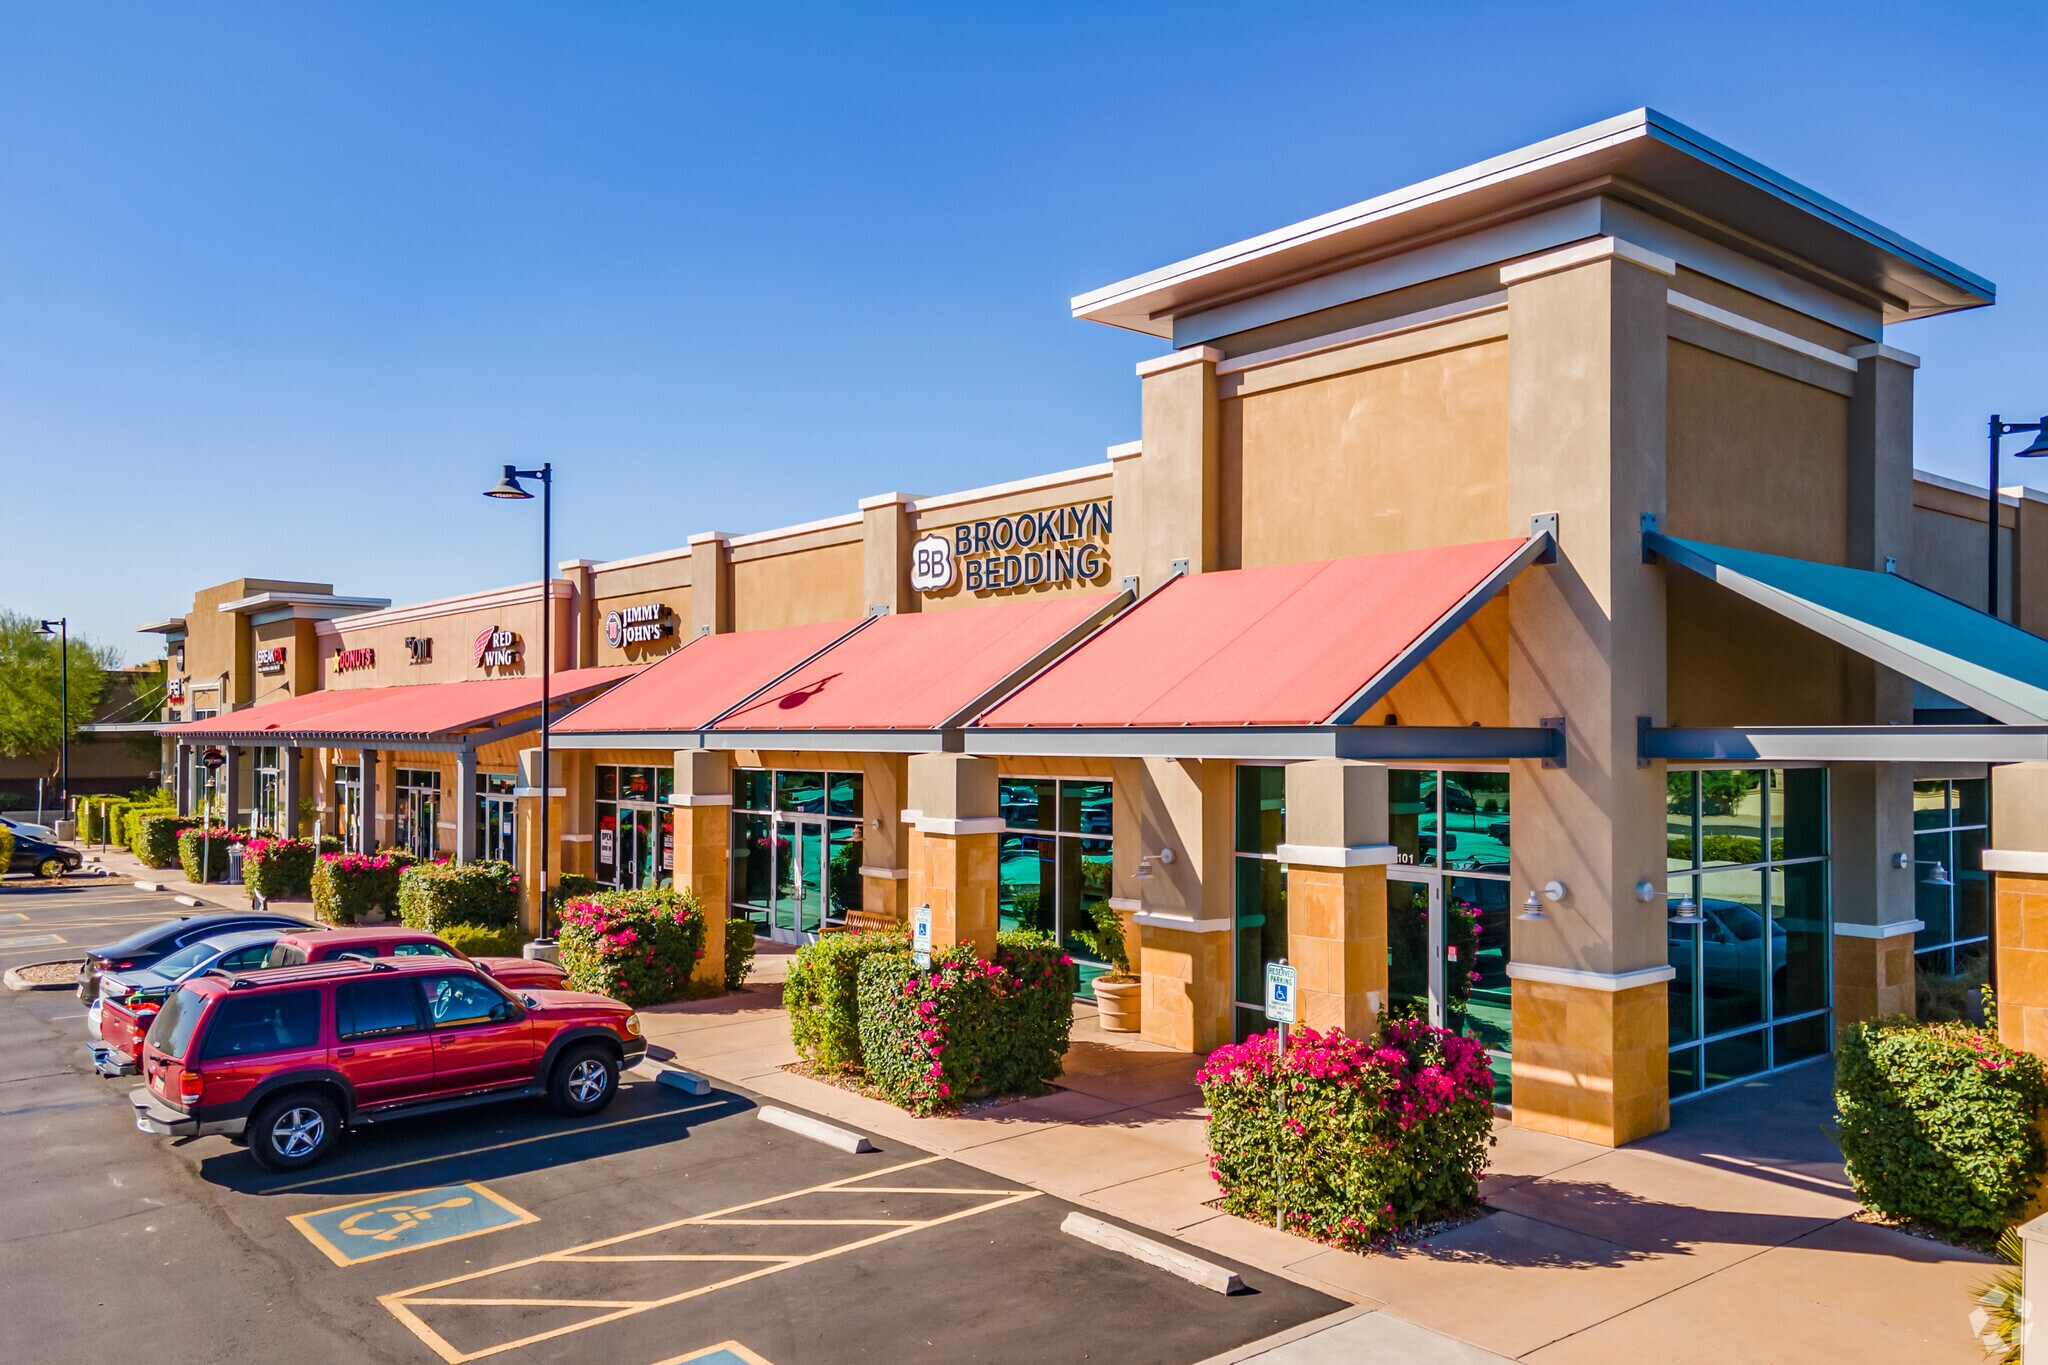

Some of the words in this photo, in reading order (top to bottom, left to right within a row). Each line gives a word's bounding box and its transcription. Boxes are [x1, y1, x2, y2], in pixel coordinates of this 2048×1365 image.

[955, 501, 1112, 556] BROOKLYN
[918, 549, 945, 578] BB
[966, 544, 1100, 591] BEDDING
[622, 604, 660, 627] JIMMY
[492, 631, 512, 648] RED
[622, 624, 661, 647] JOHN'S
[340, 649, 371, 668] DONUTS
[485, 649, 512, 666] WING
[1397, 853, 1414, 864] 101
[1269, 967, 1293, 978] RESERVED
[1270, 975, 1293, 986] PARKING
